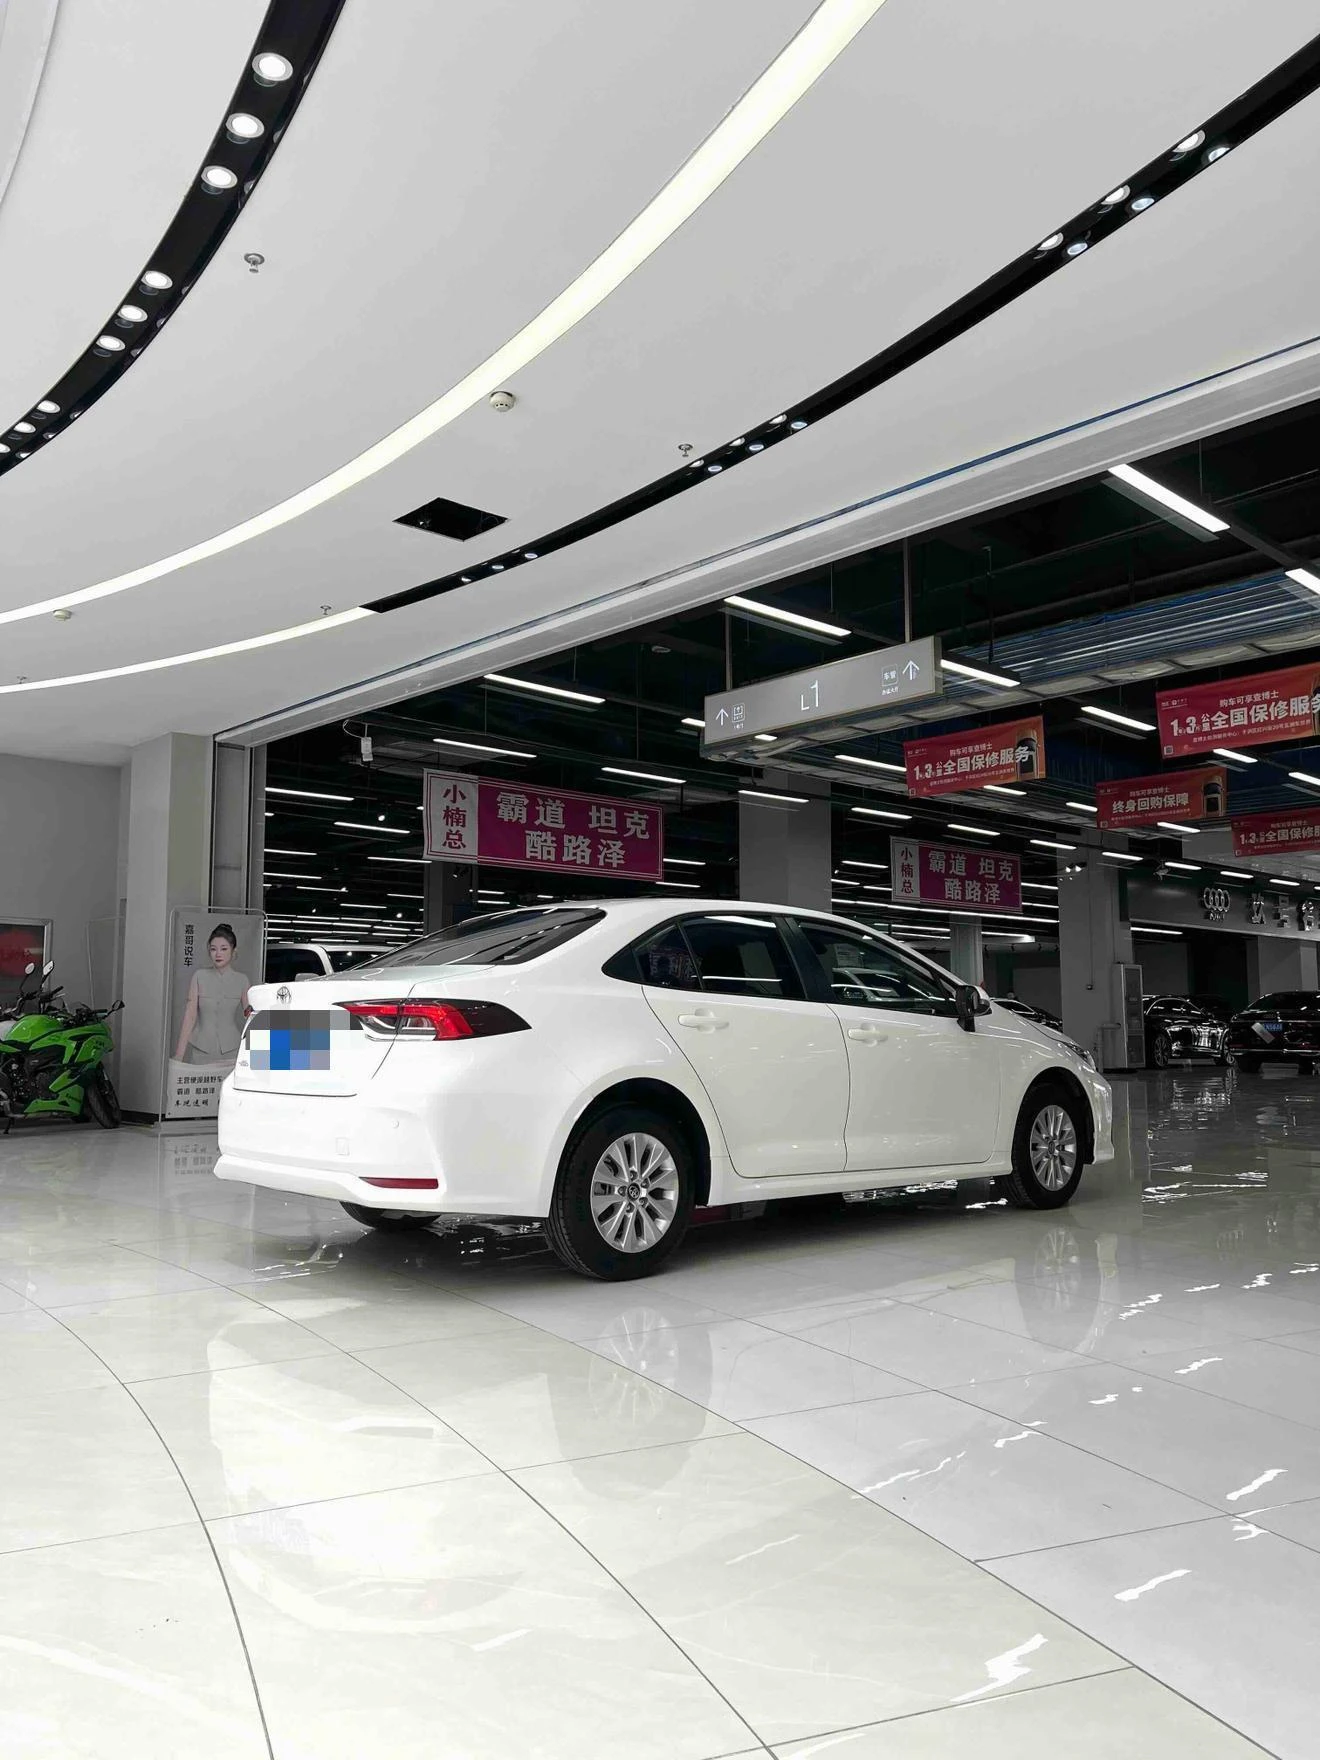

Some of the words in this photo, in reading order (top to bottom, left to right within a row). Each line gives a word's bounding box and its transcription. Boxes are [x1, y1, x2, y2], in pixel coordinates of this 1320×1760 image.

[442, 784, 467, 850] 小楠总
[496, 793, 566, 830] 霸道
[588, 805, 650, 840] 坦克
[1112, 792, 1189, 814] 终身回购保障
[524, 830, 626, 868] 酷路泽
[928, 850, 967, 877] 霸道
[978, 857, 1014, 882] 坦克
[901, 847, 914, 894] 小楠总
[944, 877, 1001, 904] 酷路泽
